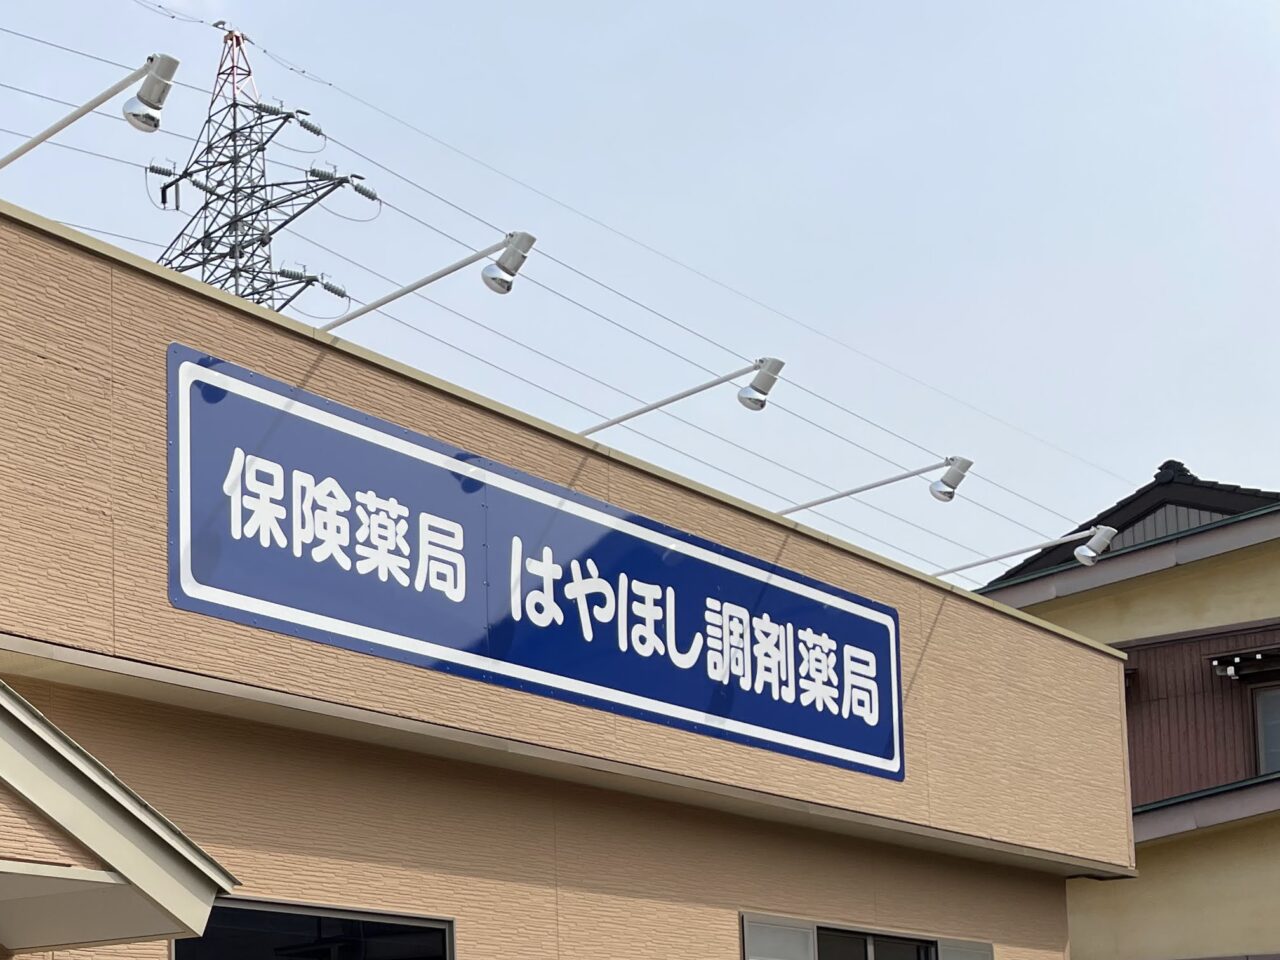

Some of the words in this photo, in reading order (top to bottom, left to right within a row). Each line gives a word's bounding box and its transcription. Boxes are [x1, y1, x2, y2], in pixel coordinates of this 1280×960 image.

[222, 446, 467, 603] 保険薬局
[510, 535, 880, 727] はやほし調剤薬局
